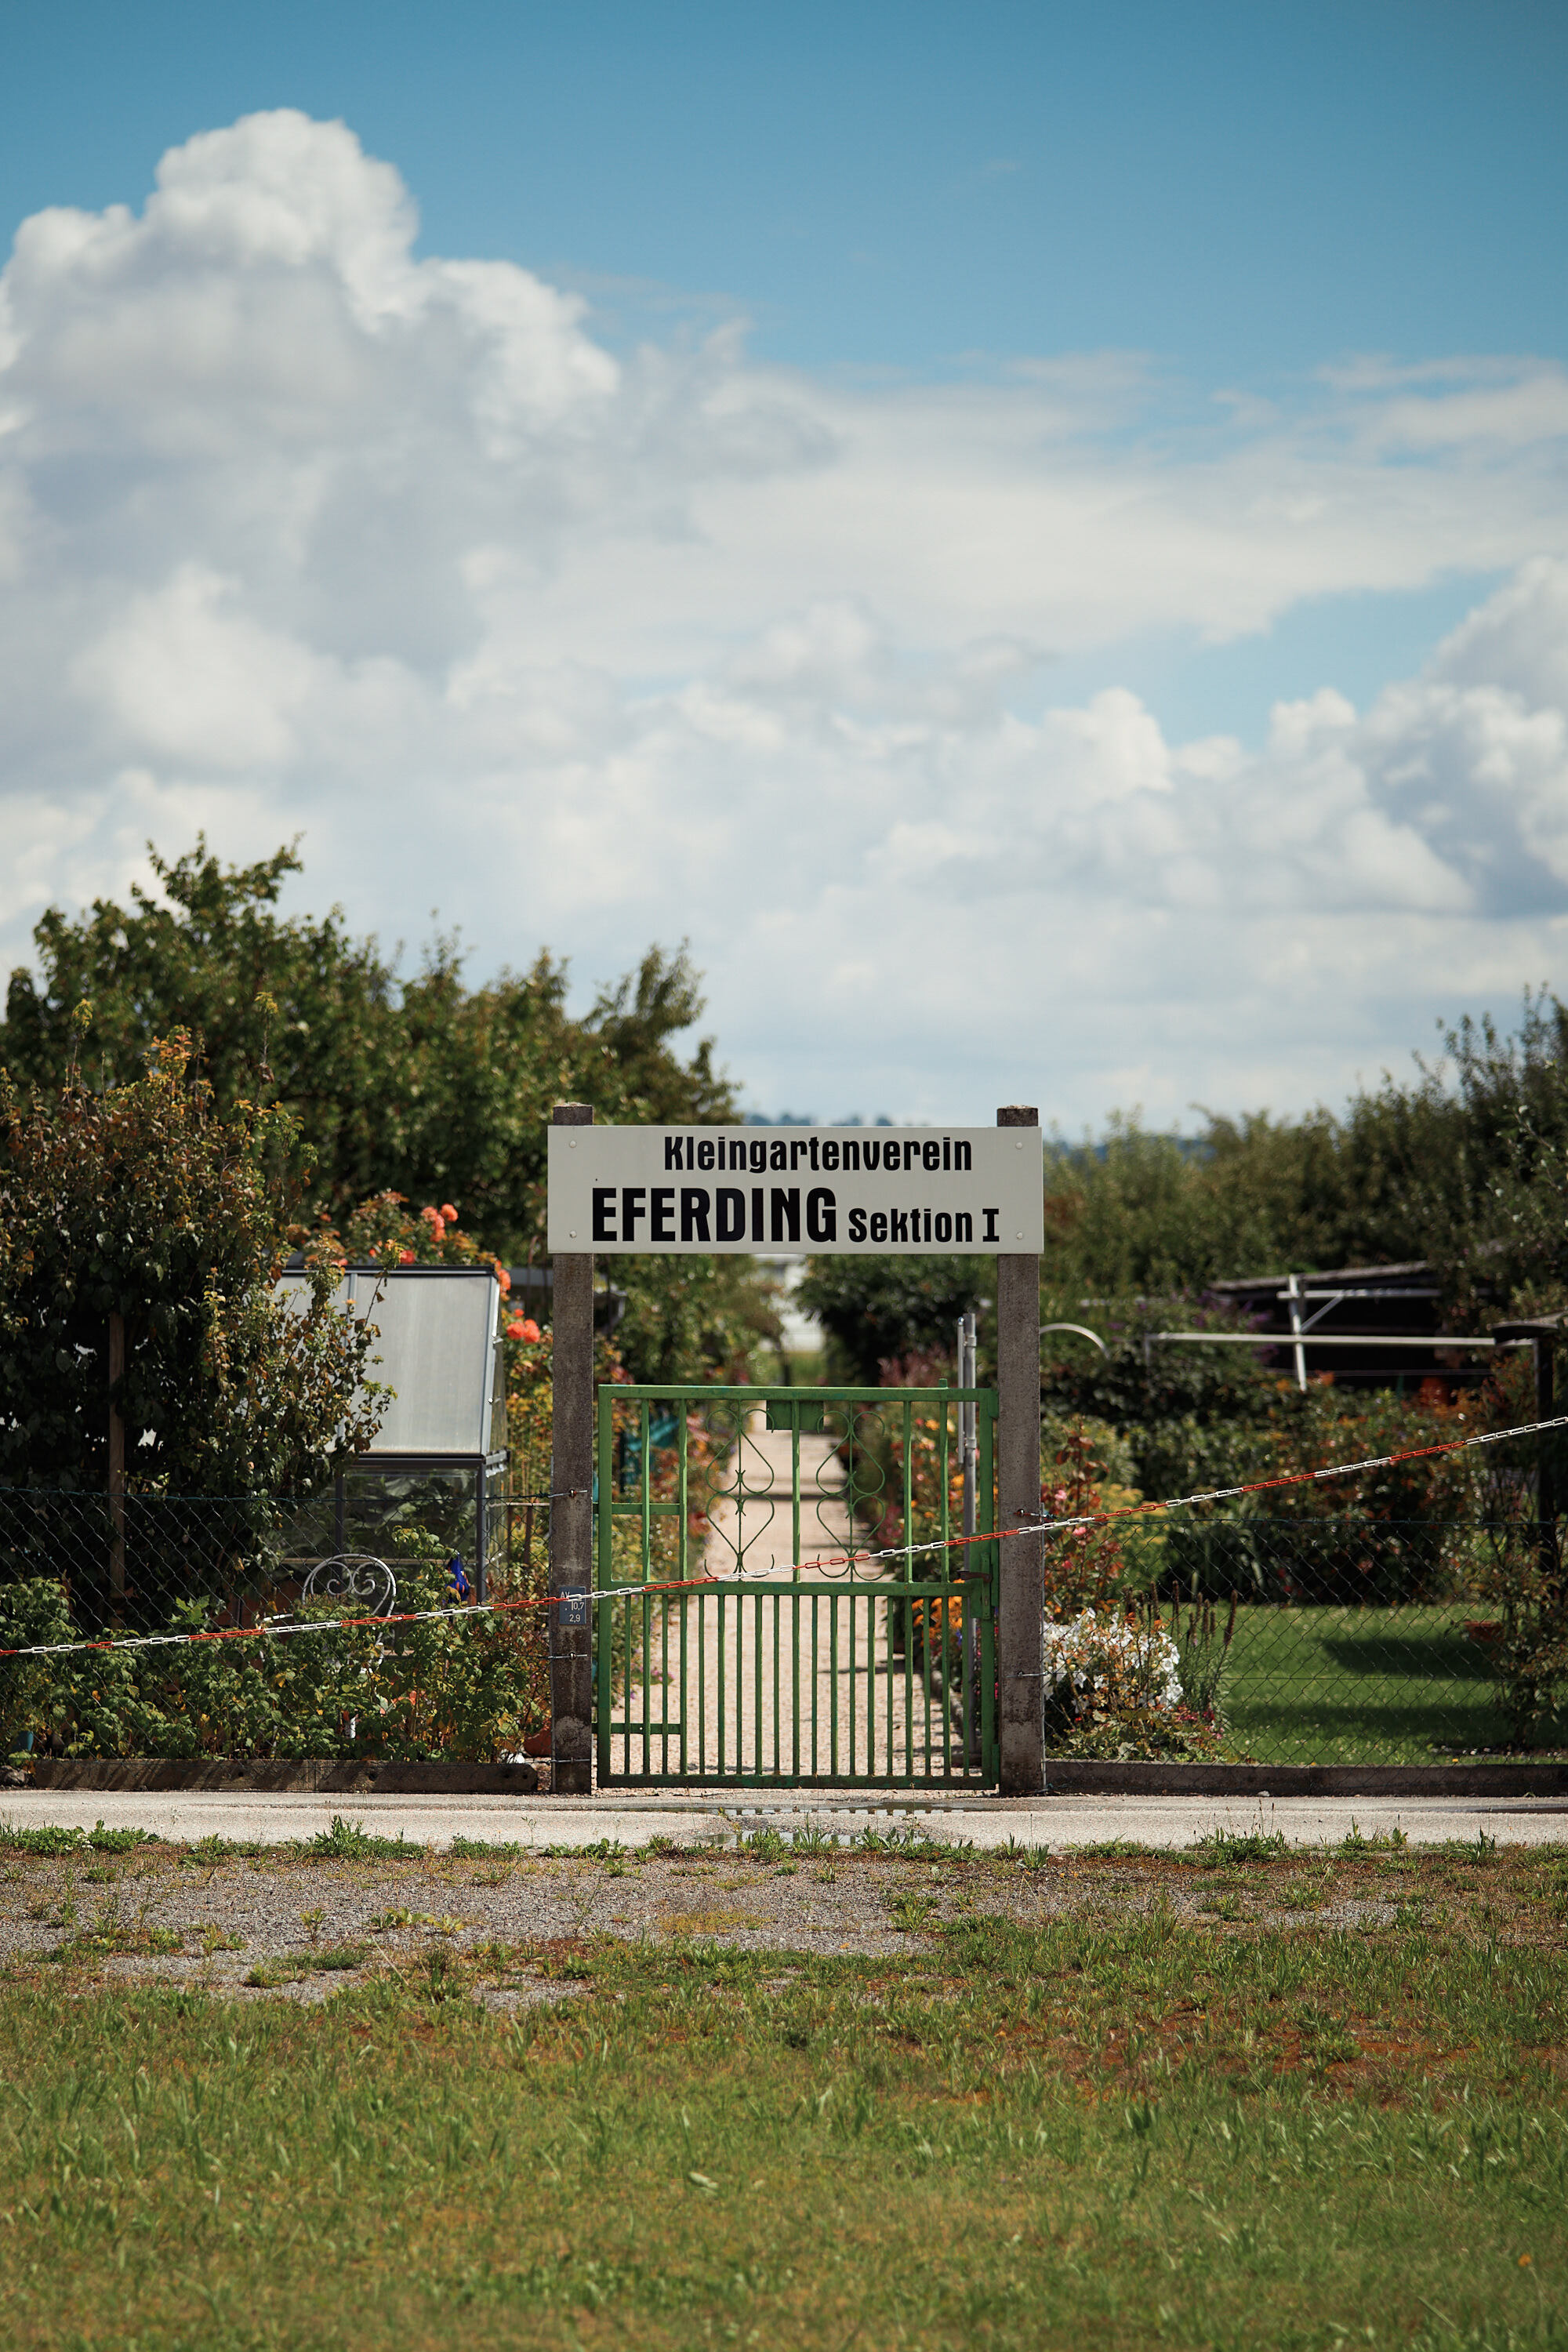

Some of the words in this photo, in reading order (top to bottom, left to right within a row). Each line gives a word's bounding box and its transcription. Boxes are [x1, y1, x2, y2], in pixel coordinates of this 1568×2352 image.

[664, 1136, 972, 1174] Kleingartenverein
[592, 1187, 837, 1243] EFERDING
[848, 1207, 973, 1243] Sektion
[982, 1208, 1000, 1243] I
[569, 1613, 581, 1623] 2,9
